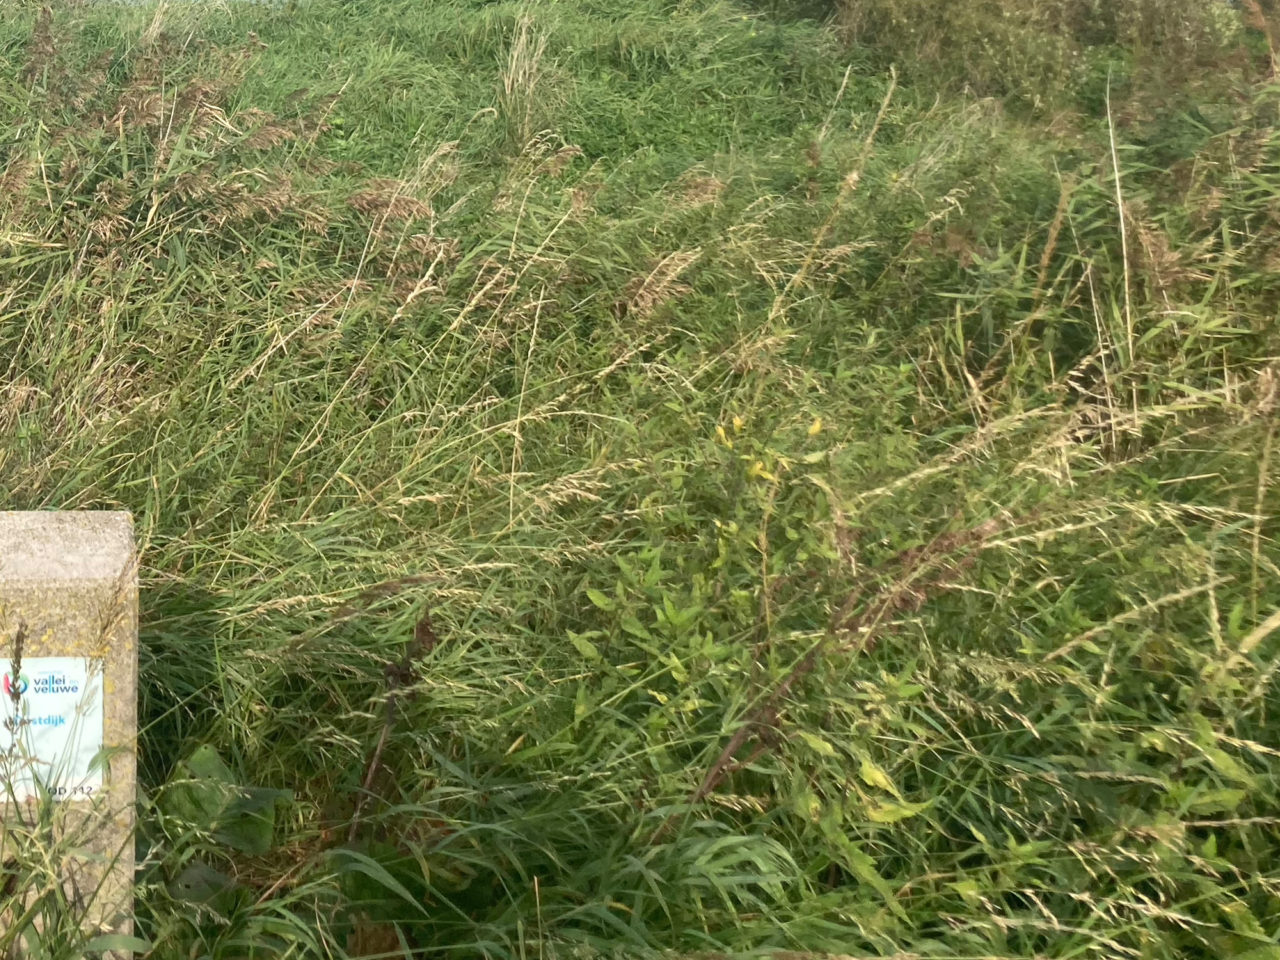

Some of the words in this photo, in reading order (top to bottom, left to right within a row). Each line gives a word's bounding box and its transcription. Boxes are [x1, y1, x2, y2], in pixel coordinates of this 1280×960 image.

[33, 674, 65, 685] vallei
[33, 684, 79, 694] veluwe
[14, 714, 65, 727] Ostdijk
